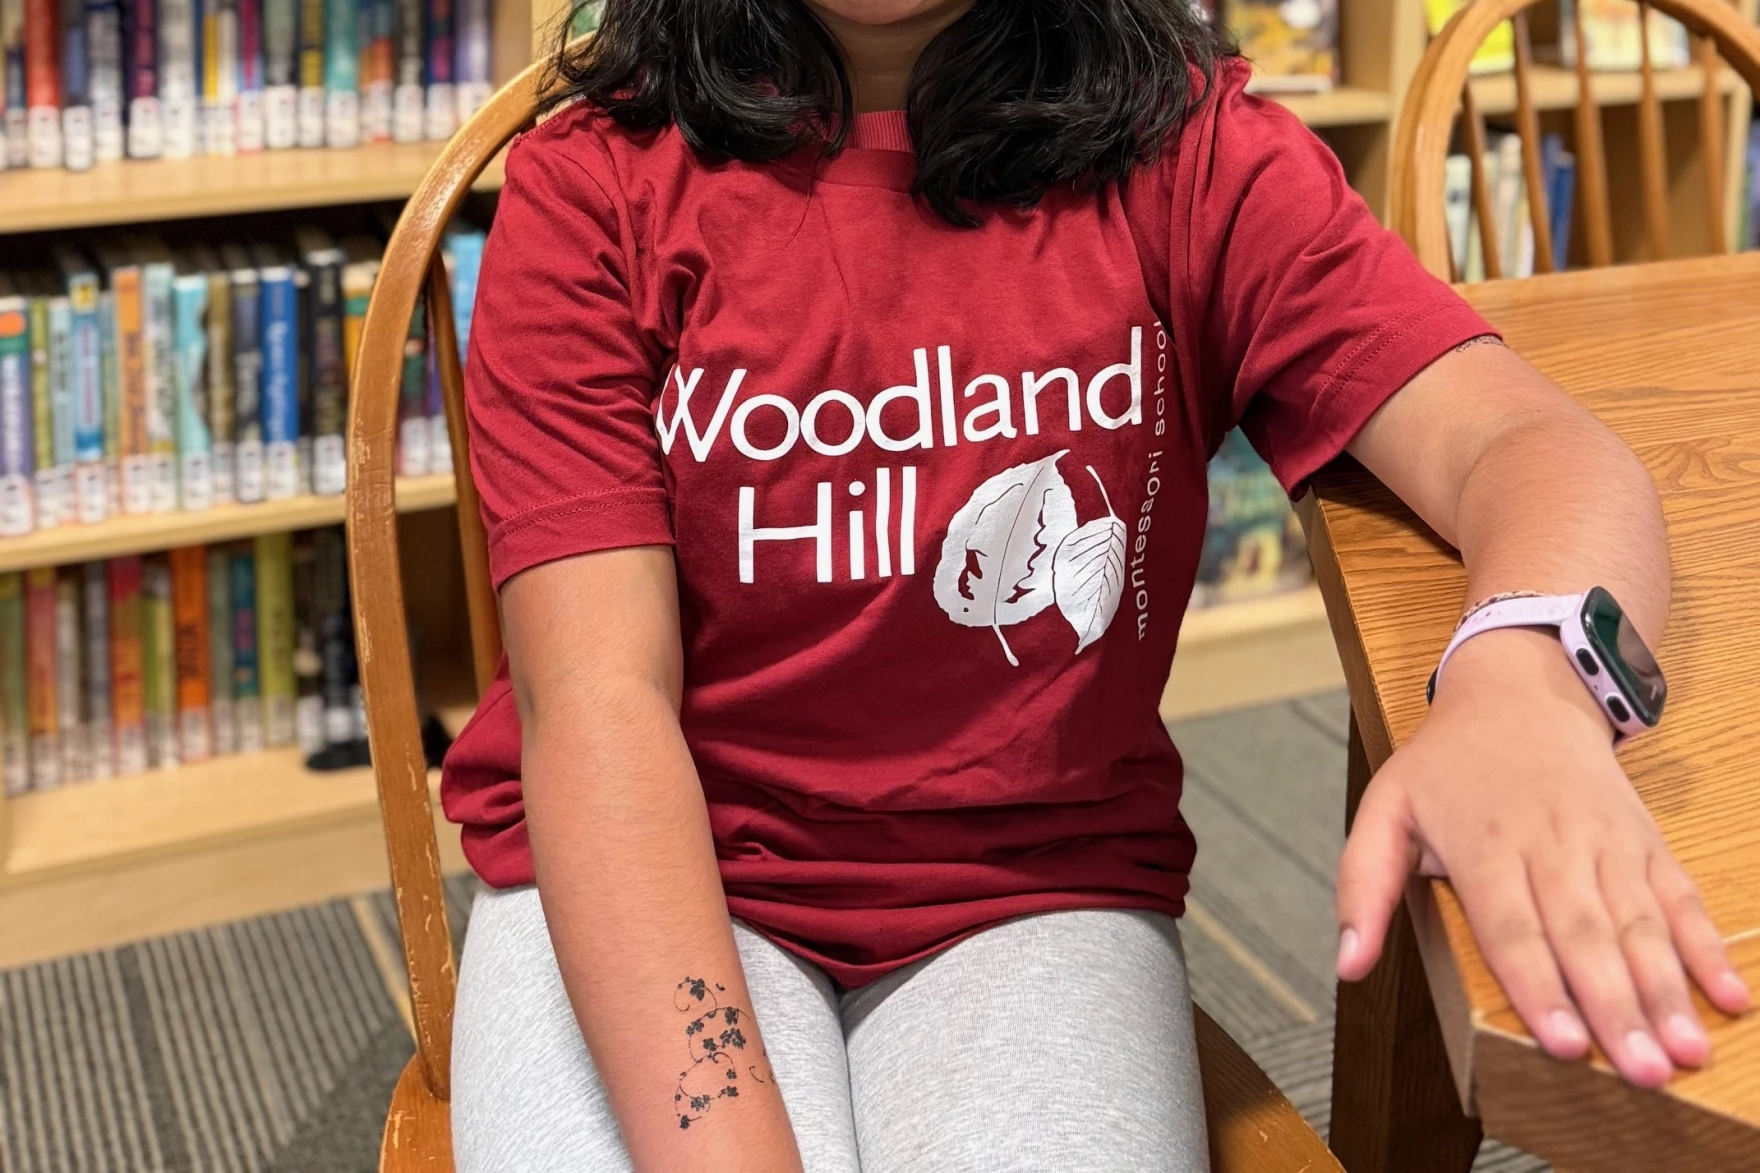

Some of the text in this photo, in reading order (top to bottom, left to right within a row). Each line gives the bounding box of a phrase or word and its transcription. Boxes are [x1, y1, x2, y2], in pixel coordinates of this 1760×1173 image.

[656, 326, 1143, 462] Woodland
[739, 466, 916, 584] Hill
[1130, 450, 1162, 641] montessori
